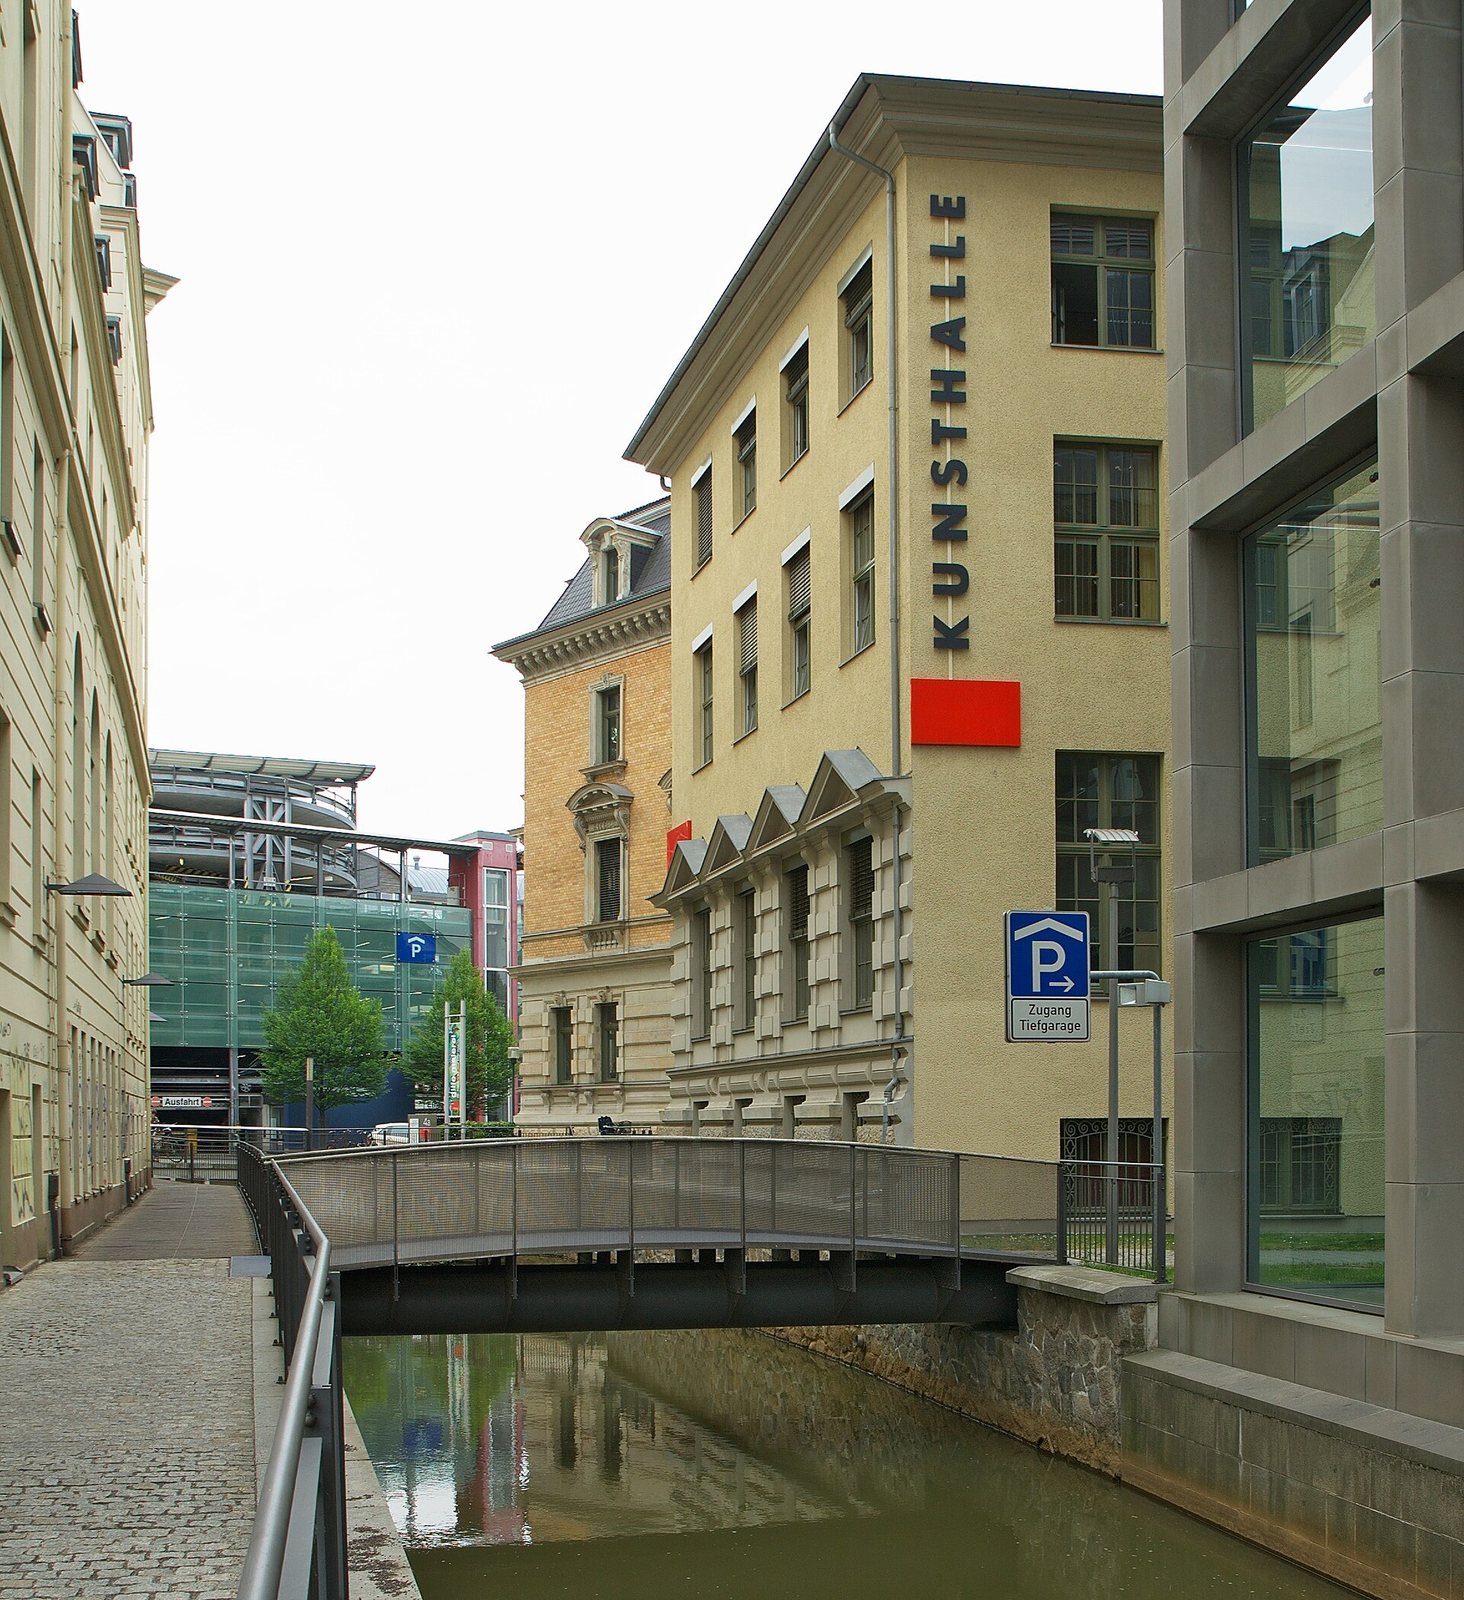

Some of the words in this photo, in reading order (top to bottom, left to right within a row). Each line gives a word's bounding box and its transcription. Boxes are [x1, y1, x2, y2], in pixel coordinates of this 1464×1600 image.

[930, 194, 970, 649] KUNSTHALLE
[411, 943, 422, 958] P
[1031, 940, 1066, 993] P
[1028, 1003, 1072, 1018] Zugang
[1019, 1019, 1081, 1034] Tiefgarage
[164, 1097, 200, 1106] Ausfahrt
